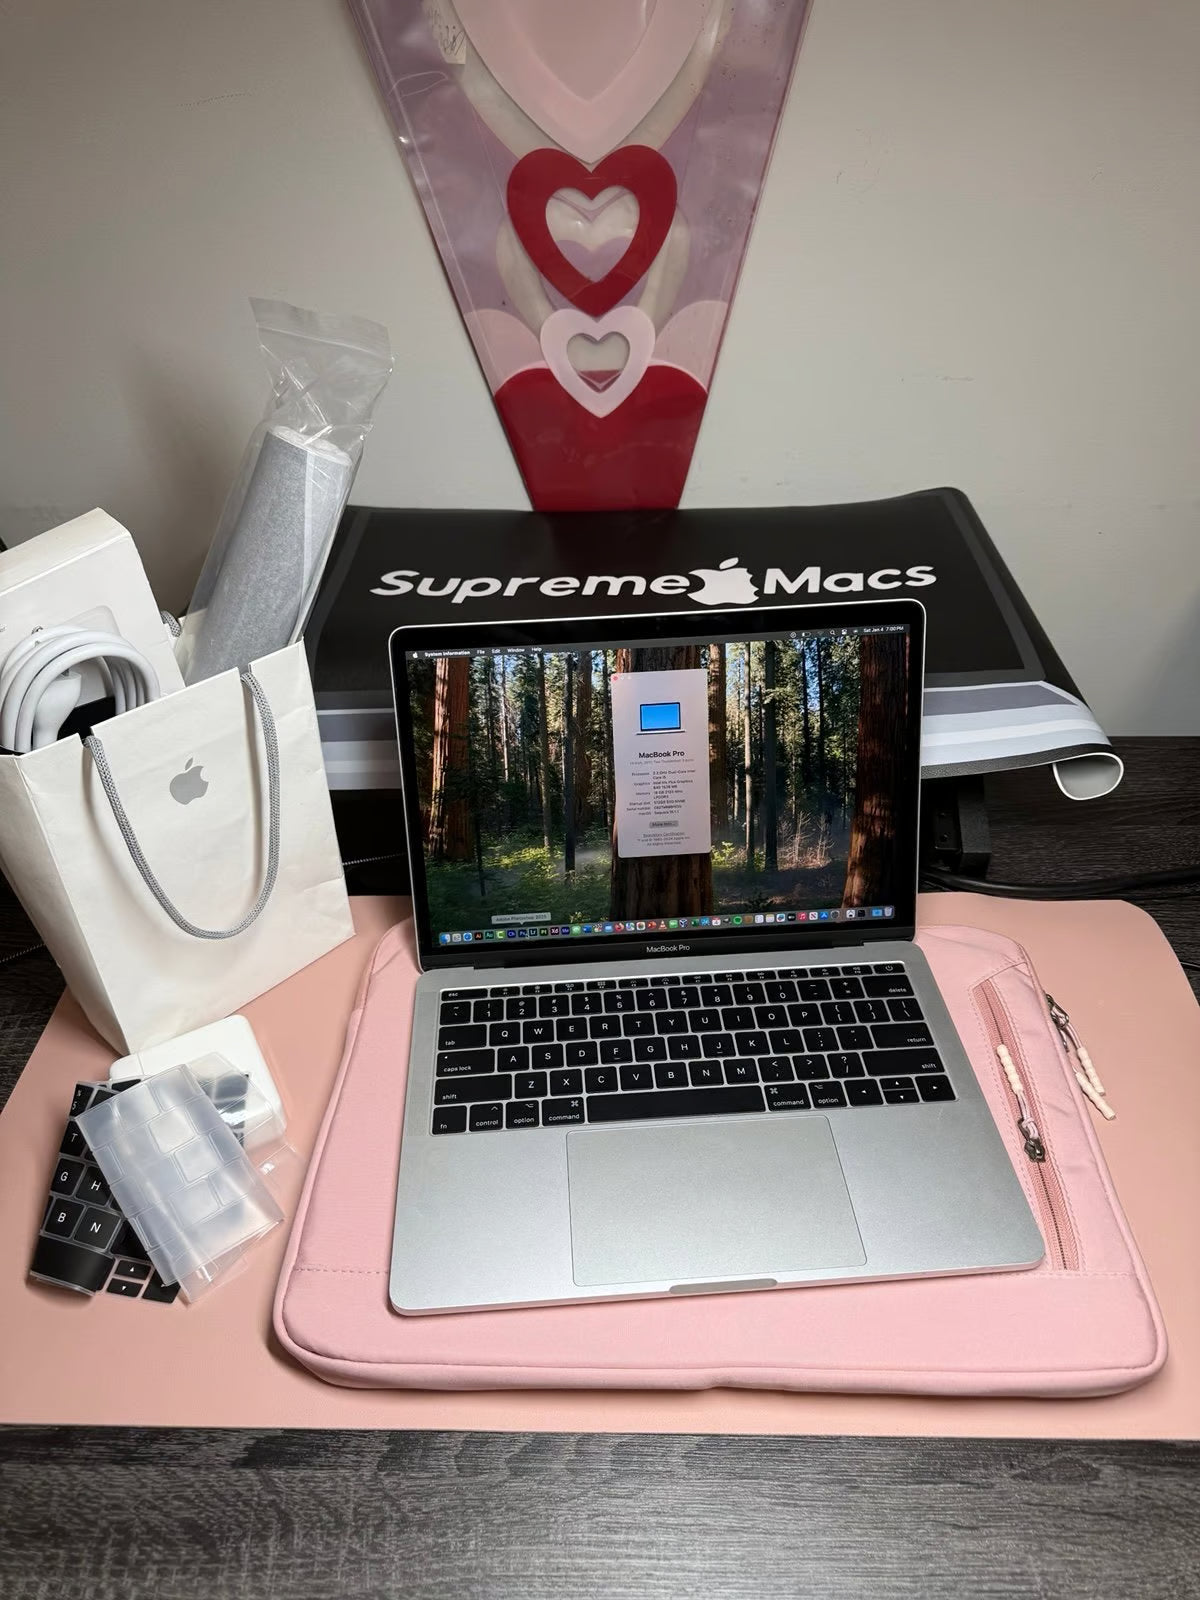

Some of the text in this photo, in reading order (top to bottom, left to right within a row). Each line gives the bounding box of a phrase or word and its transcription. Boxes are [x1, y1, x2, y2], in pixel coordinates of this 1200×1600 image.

[370, 565, 937, 604] Supreme Macs
[638, 751, 671, 759] MacBook
[646, 943, 691, 953] MacBook Pro
[486, 991, 787, 1018] 1 2 3 4 5 6 7 8 9 0
[501, 1030, 509, 1038] Q
[533, 1027, 543, 1035] W
[568, 1025, 575, 1033] E
[601, 1022, 609, 1030] R
[635, 1020, 642, 1028] T
[701, 1016, 709, 1024] U
[767, 1012, 776, 1021] O
[801, 1011, 808, 1019] P
[509, 1055, 517, 1063] A
[544, 1052, 552, 1060] S
[578, 1049, 586, 1058] D
[613, 1047, 619, 1055] F
[646, 1045, 655, 1053] G
[680, 1043, 689, 1051] H
[716, 1041, 722, 1049] J
[748, 1039, 756, 1047] K
[783, 1037, 790, 1046] L
[528, 1080, 535, 1089] Z
[563, 1078, 570, 1086] X
[597, 1075, 605, 1084] C
[632, 1073, 640, 1081] V
[667, 1071, 675, 1079] B
[702, 1069, 711, 1077] N
[736, 1067, 746, 1075] M
[475, 1119, 499, 1127] control
[513, 1116, 535, 1125] option
[548, 1113, 580, 1122] command
[772, 1098, 805, 1107] command
[817, 1097, 839, 1105] option
[71, 1132, 79, 1143] T
[60, 1171, 102, 1192] G H
[57, 1211, 102, 1234] B N
